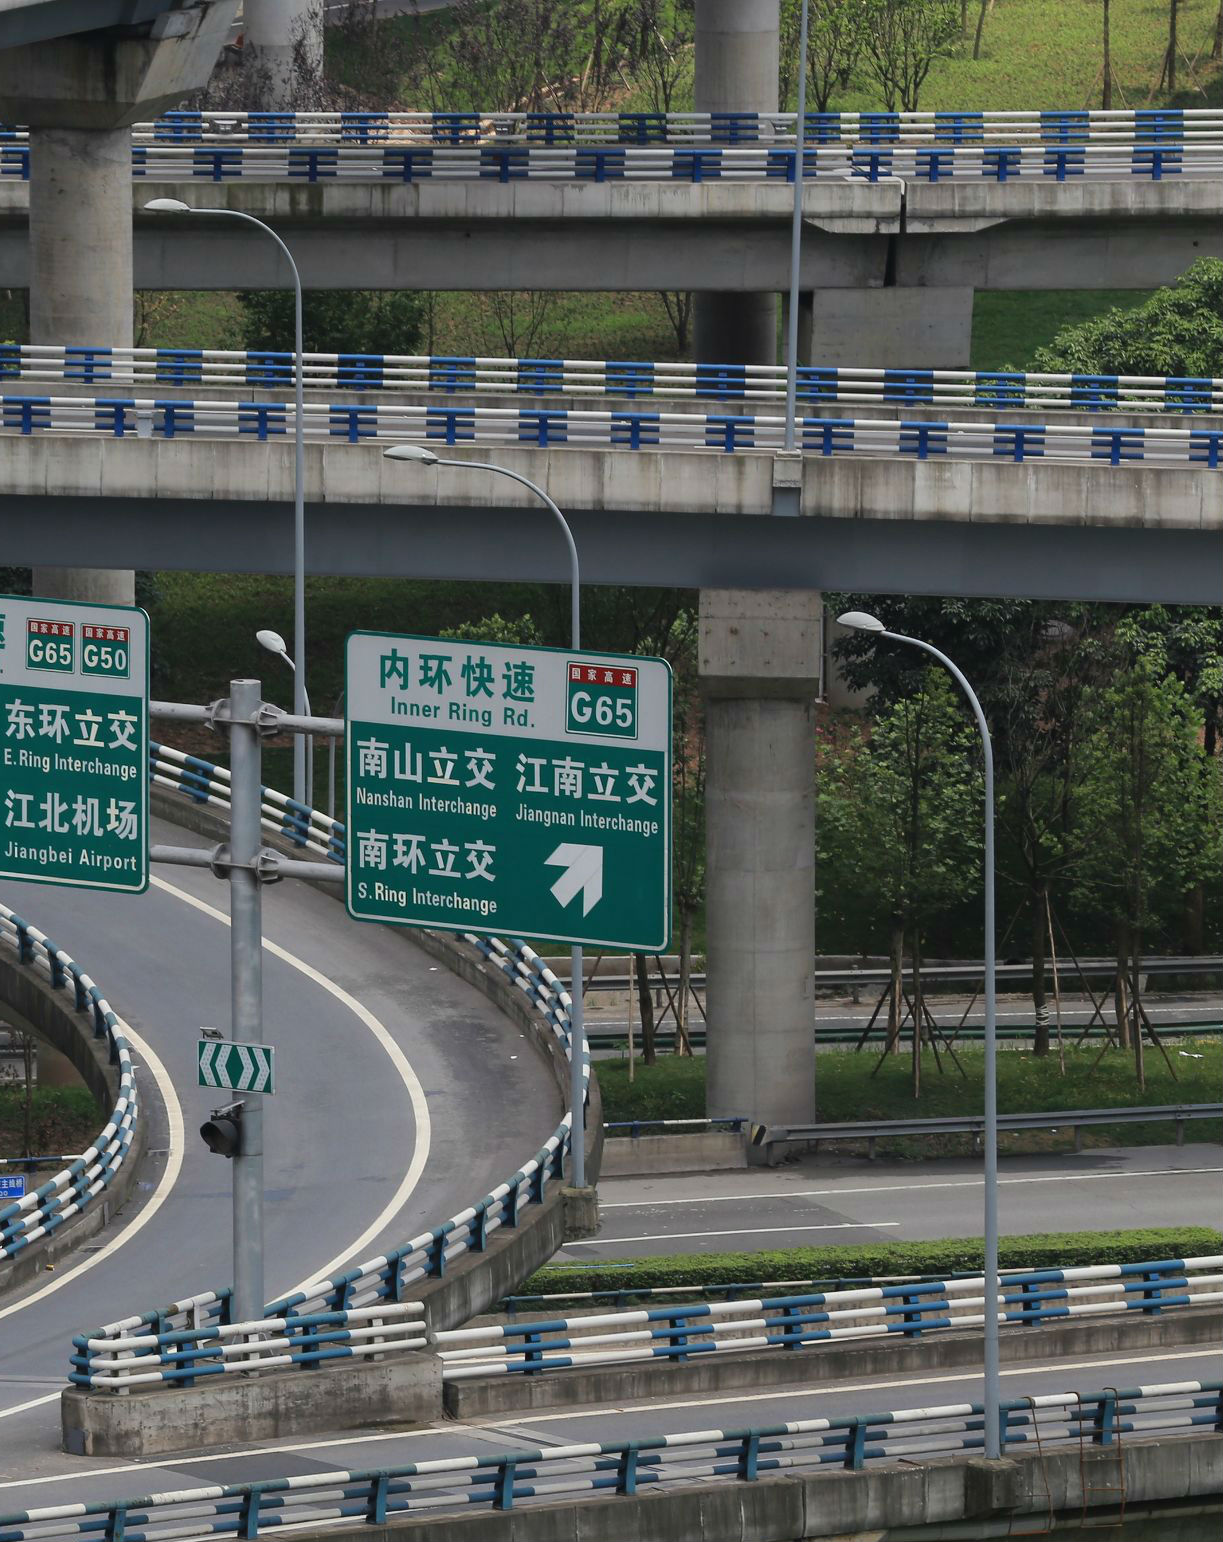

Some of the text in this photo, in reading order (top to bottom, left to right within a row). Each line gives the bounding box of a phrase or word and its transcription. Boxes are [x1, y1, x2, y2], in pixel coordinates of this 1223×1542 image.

[30, 621, 71, 636] 国家高速
[85, 627, 125, 641] 国家高速
[29, 639, 72, 665] G65
[83, 644, 127, 671] G50
[379, 648, 535, 703] 内环快速
[571, 667, 632, 685] 国家高速
[4, 698, 138, 752] 东环立交
[391, 696, 535, 728] Inner Ring Rd.
[571, 691, 633, 728] G65
[55, 752, 137, 781] Interchange
[356, 736, 496, 791] 南山立交
[515, 752, 658, 806] 江南立交
[4, 788, 138, 840] 江北机场
[356, 786, 497, 821] Nanshan Interchange
[515, 803, 658, 837] Jiangnan Interchange
[4, 840, 137, 872] Jiangbei Airport
[356, 828, 496, 882] 南环立交
[412, 887, 497, 916] Interchange
